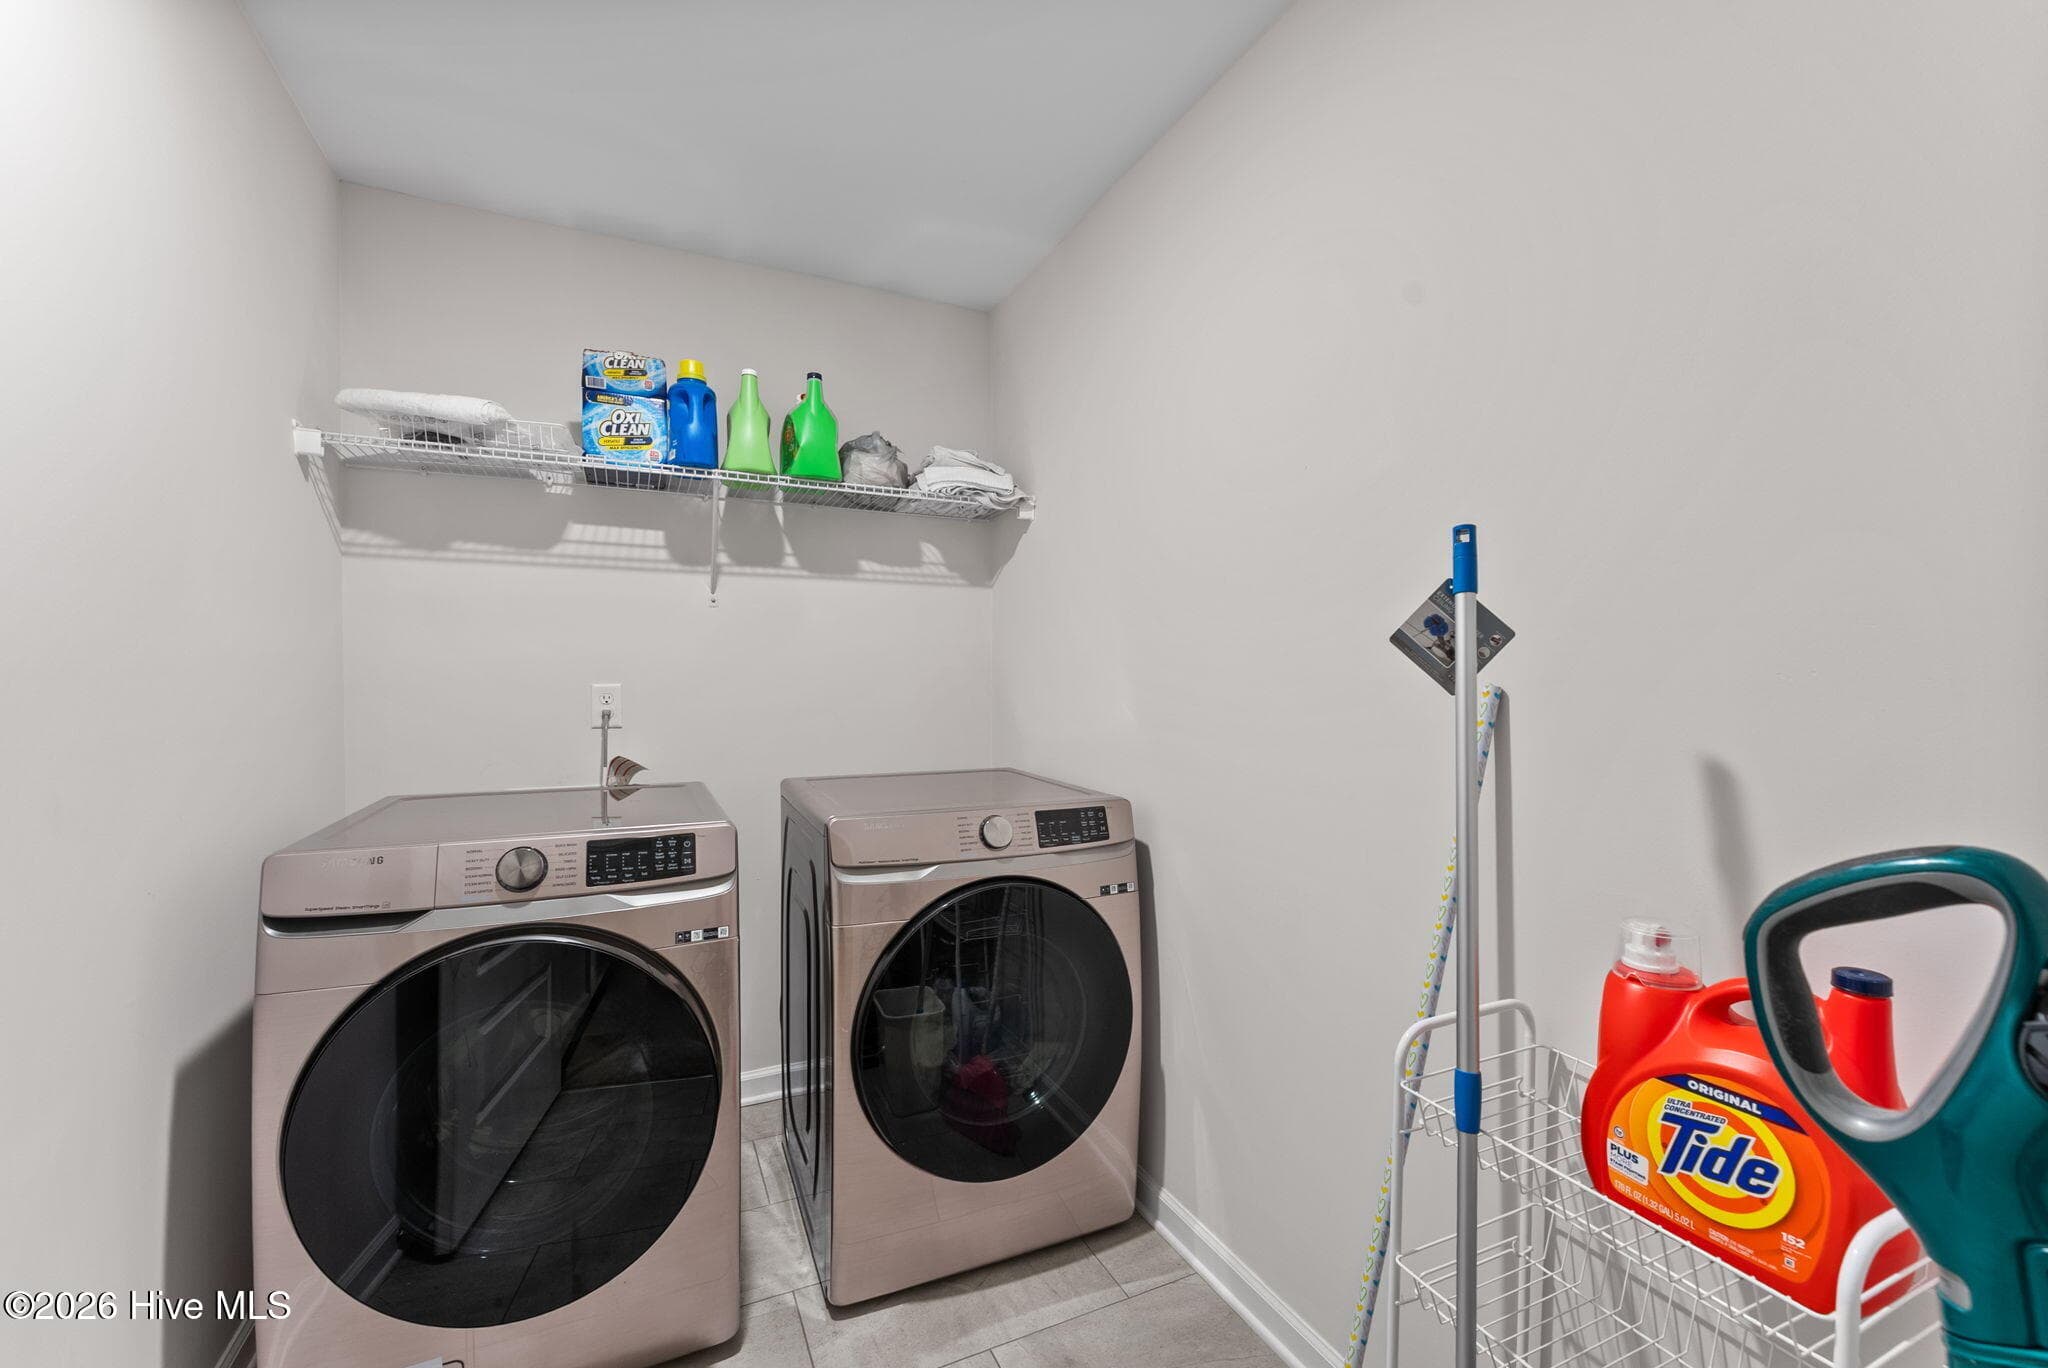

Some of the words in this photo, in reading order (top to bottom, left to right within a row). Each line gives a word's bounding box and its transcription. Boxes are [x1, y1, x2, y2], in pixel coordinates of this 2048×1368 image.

[604, 356, 646, 369] CLEAN
[612, 409, 641, 424] OXI
[600, 420, 650, 436] CLEAN
[1667, 1097, 1692, 1108] ULTRA
[1687, 1079, 1762, 1115] ORIGINAL
[1664, 1103, 1727, 1124] CONCENTRATED
[1610, 1143, 1639, 1164] PLUS
[1660, 1111, 1781, 1196] Tide
[1674, 1212, 1690, 1227] 5.02
[1781, 1231, 1806, 1250] 152
